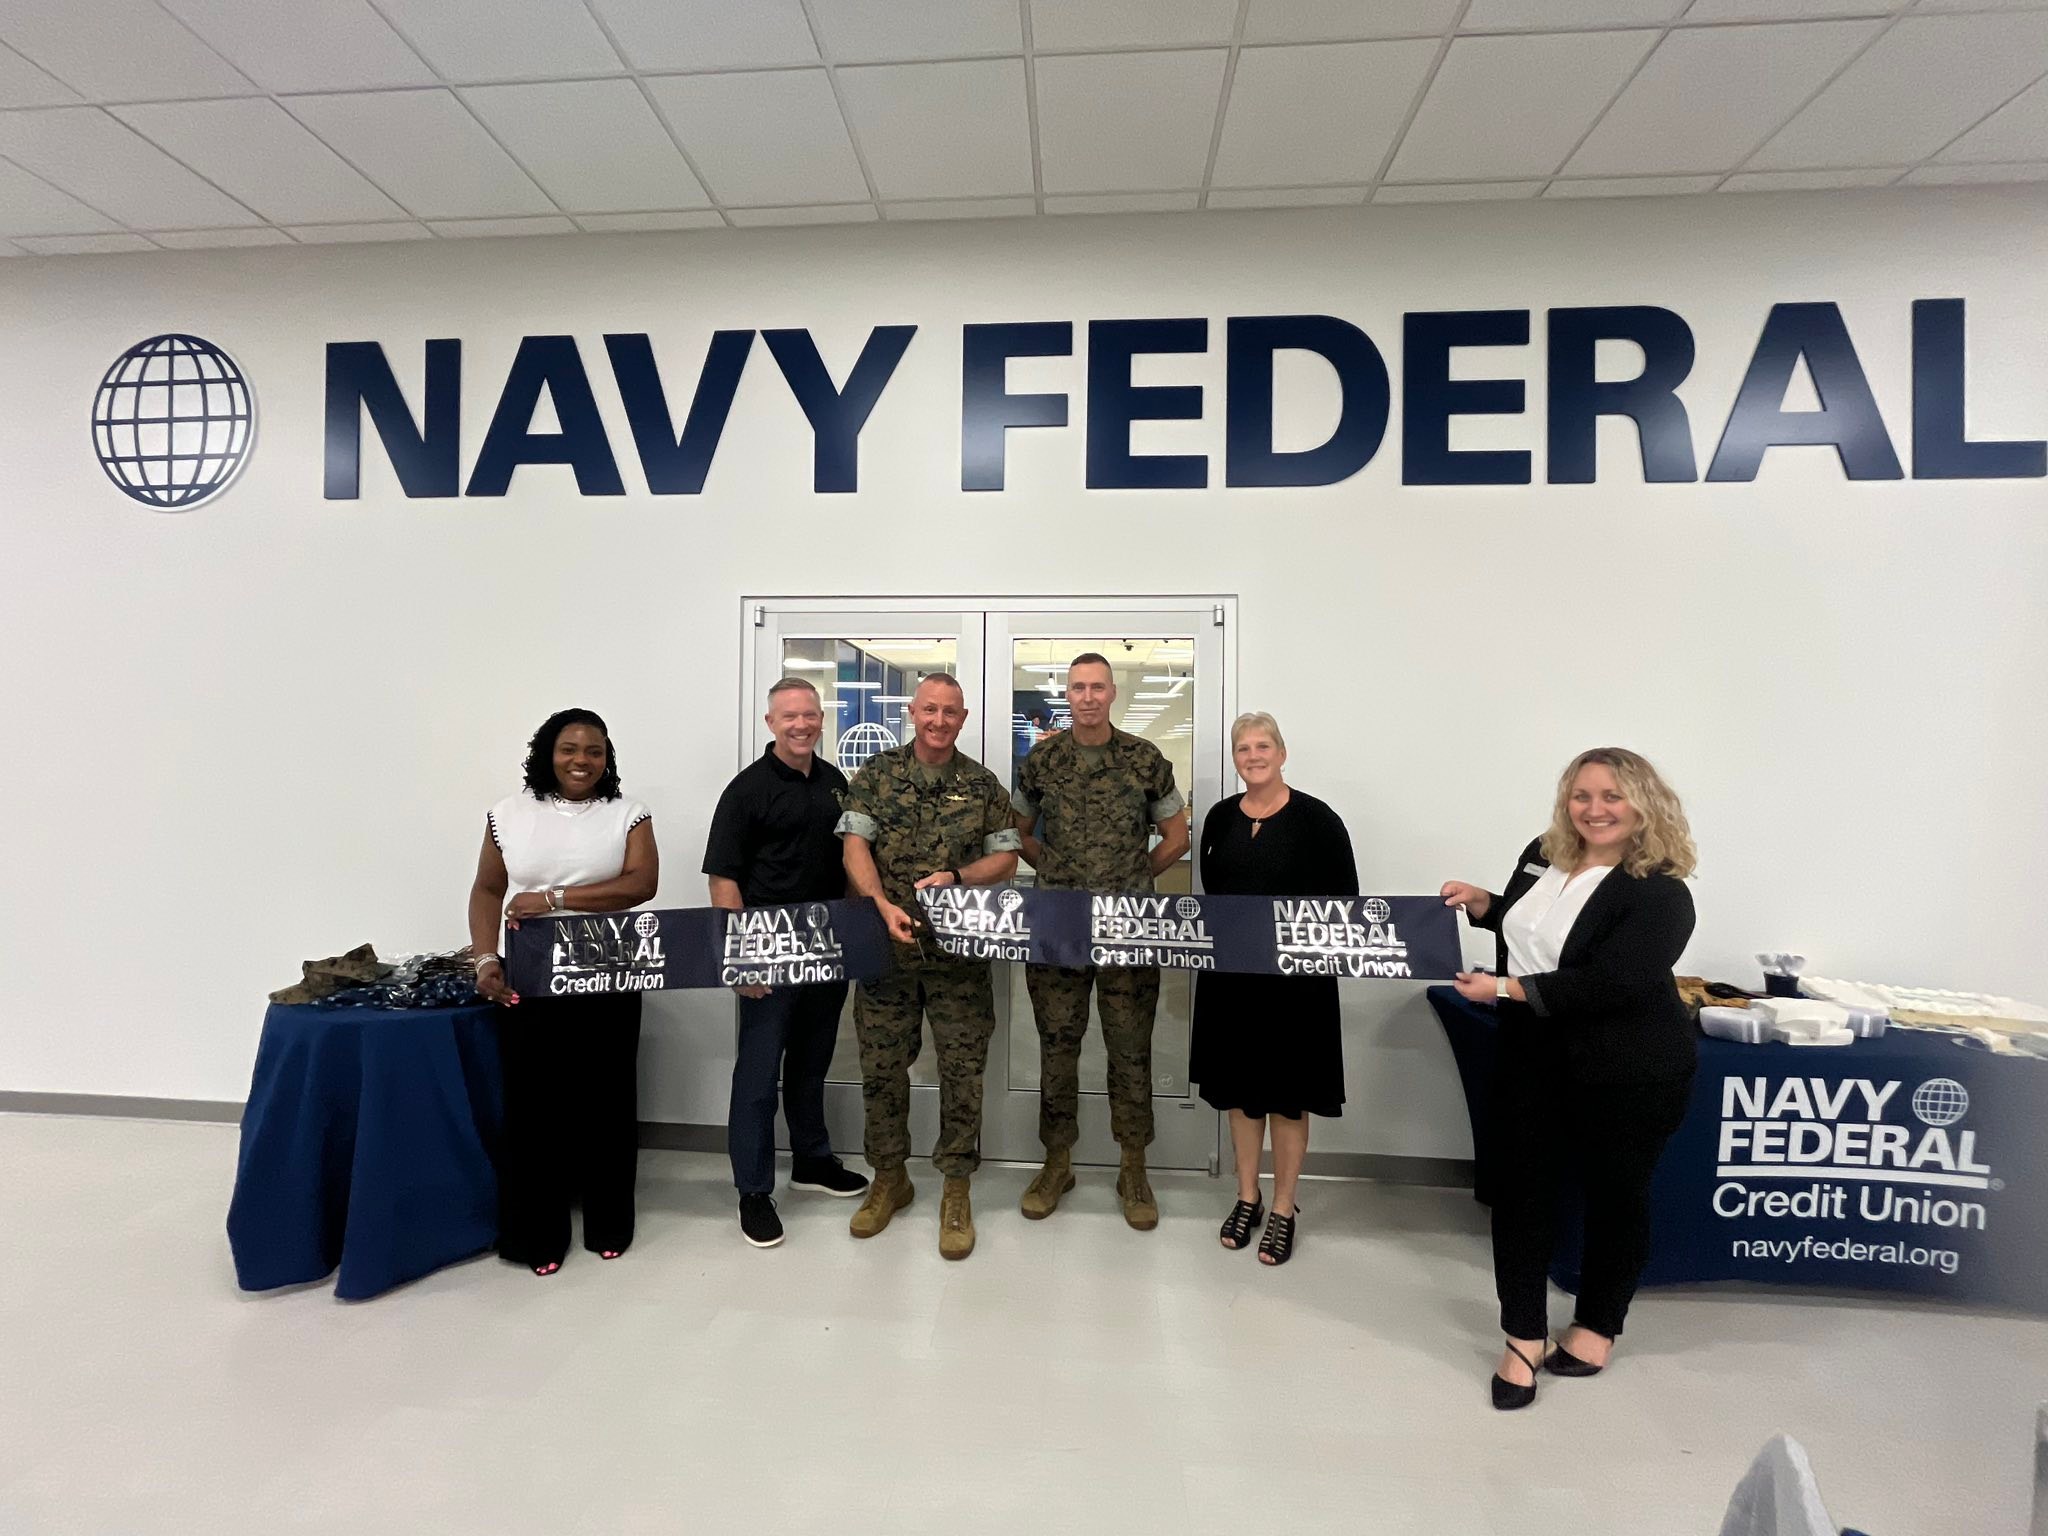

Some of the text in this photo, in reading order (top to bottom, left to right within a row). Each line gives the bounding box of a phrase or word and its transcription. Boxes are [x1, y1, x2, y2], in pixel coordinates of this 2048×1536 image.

[323, 298, 2047, 500] NAVY FEDERAL
[923, 905, 1031, 934] EDERAL
[1091, 895, 1169, 918] NAVY
[1273, 900, 1354, 922] NAVY
[554, 916, 628, 942] NAVY
[726, 908, 799, 934] NAVY
[1091, 916, 1213, 941] FEDERAL
[1275, 921, 1405, 947] FEDERAL
[552, 936, 665, 966] FEDERAL
[724, 927, 841, 957] FEDERAL
[973, 940, 1030, 961] Union
[1090, 946, 1215, 970] Credit Union
[1277, 953, 1412, 977] Credit Union
[549, 969, 664, 995] Credit Union
[722, 960, 844, 986] Credit Union
[1720, 1075, 1902, 1121] NAVY
[1717, 1120, 1991, 1174] FEDERAL
[1712, 1181, 1987, 1231] Credit Union
[1731, 1235, 1960, 1275] navyfederal.org
